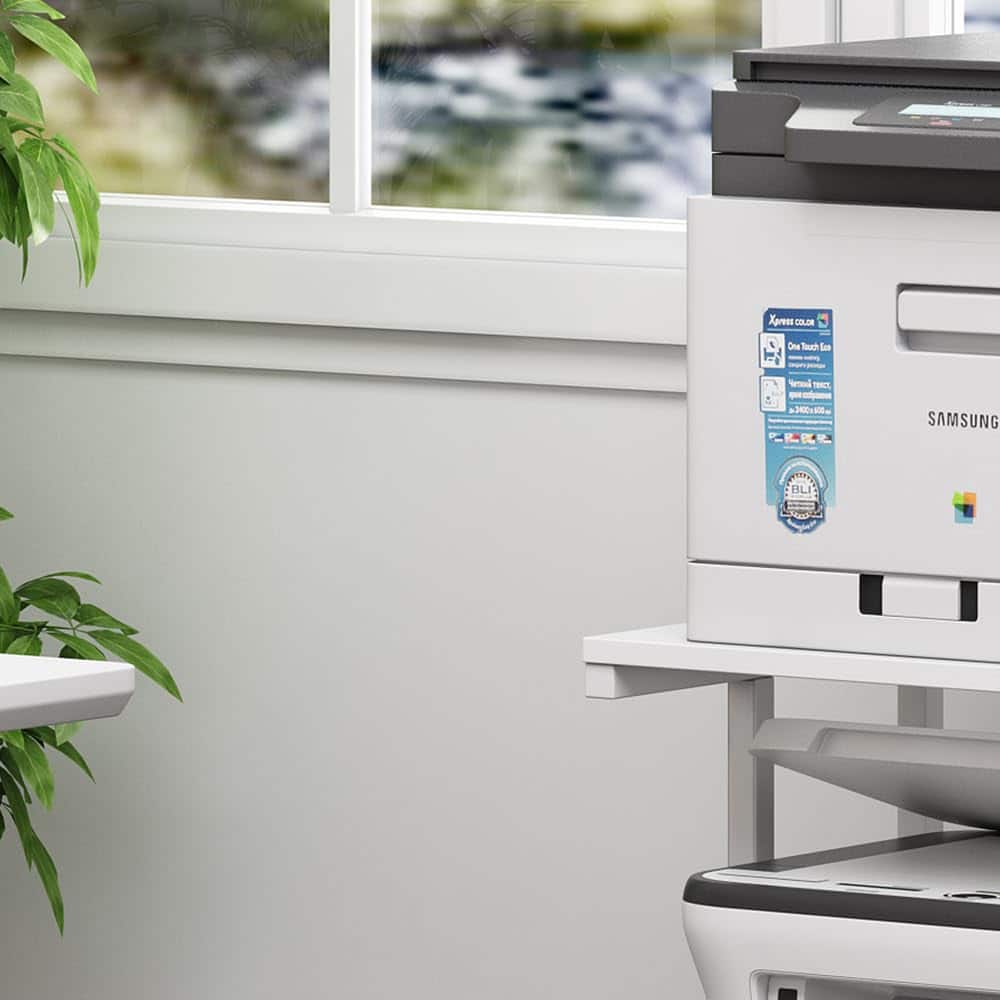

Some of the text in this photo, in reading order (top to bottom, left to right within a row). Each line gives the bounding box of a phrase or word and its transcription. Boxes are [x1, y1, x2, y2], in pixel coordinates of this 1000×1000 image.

[769, 313, 794, 327] Xpress
[788, 342, 800, 351] One
[801, 342, 819, 352] Touch
[928, 410, 999, 430] SAMSUNG
[791, 484, 812, 494] BLI
